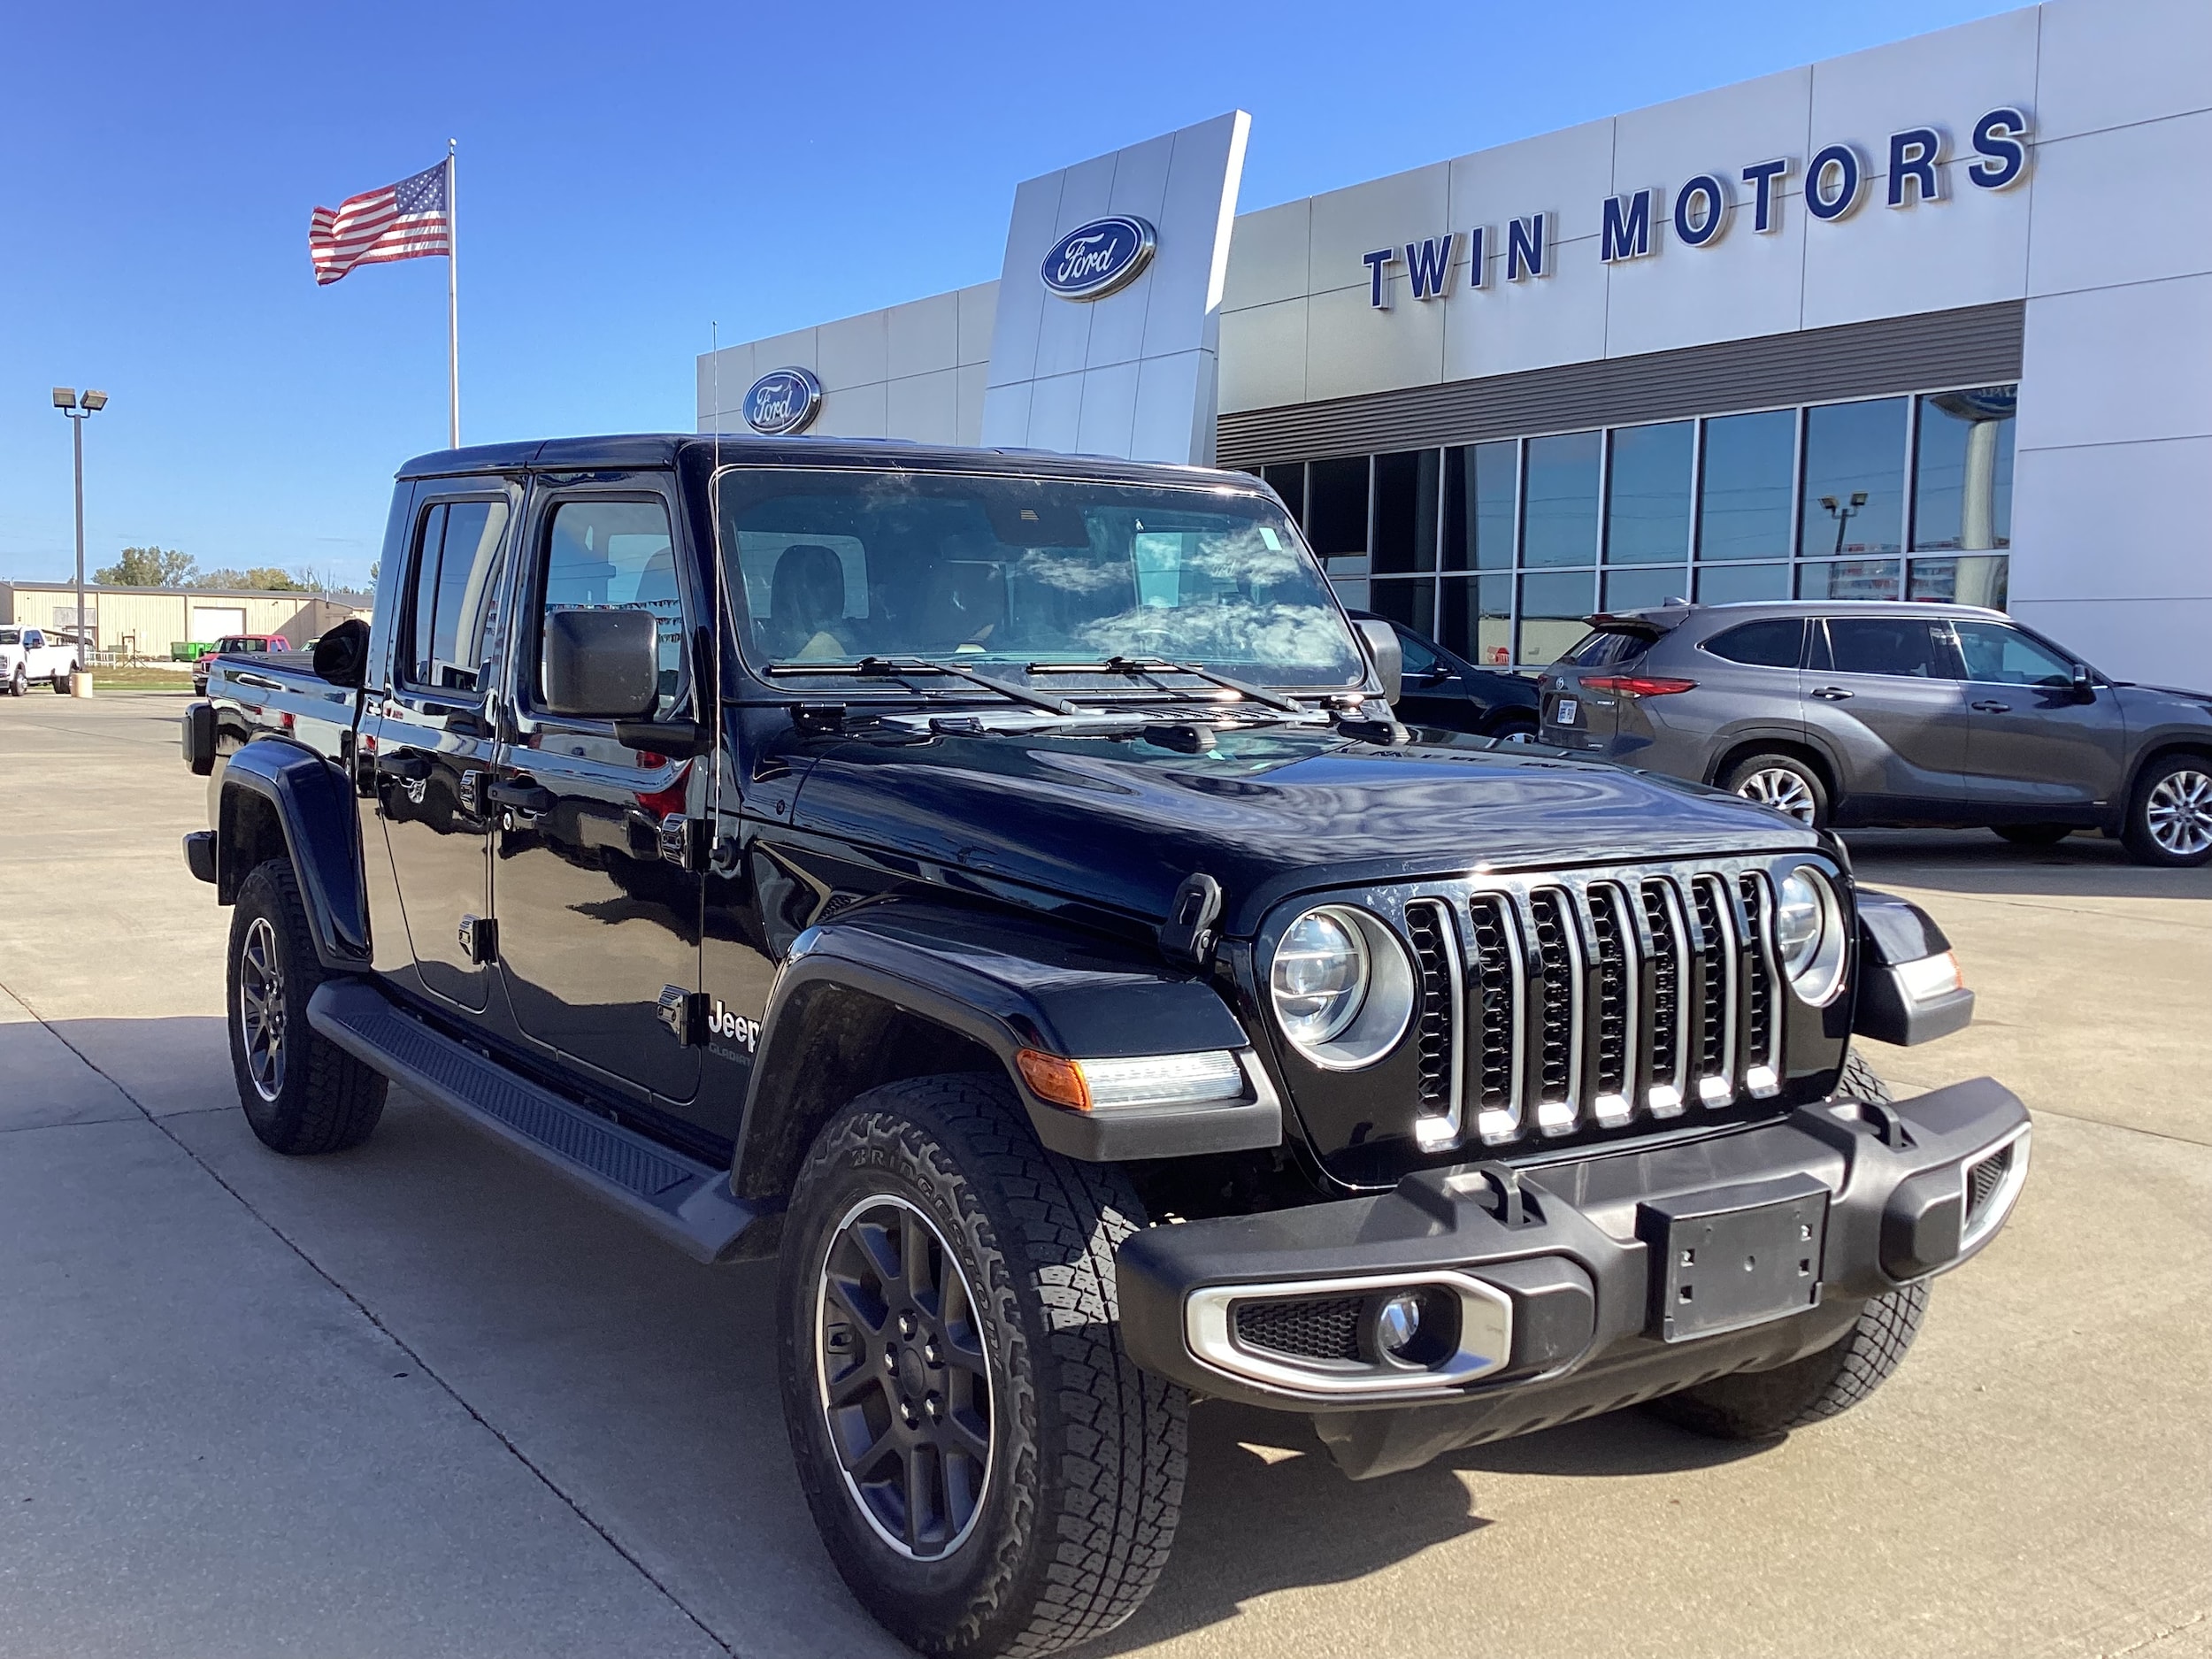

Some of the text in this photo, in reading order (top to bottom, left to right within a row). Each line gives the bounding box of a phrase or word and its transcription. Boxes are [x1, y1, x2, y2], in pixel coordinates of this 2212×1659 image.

[1361, 106, 2031, 310] TWIN MOTORS
[1057, 233, 1118, 282] Ford
[753, 384, 793, 425] Ford
[708, 999, 760, 1054] Jeep
[709, 1041, 751, 1068] GLADIAT
